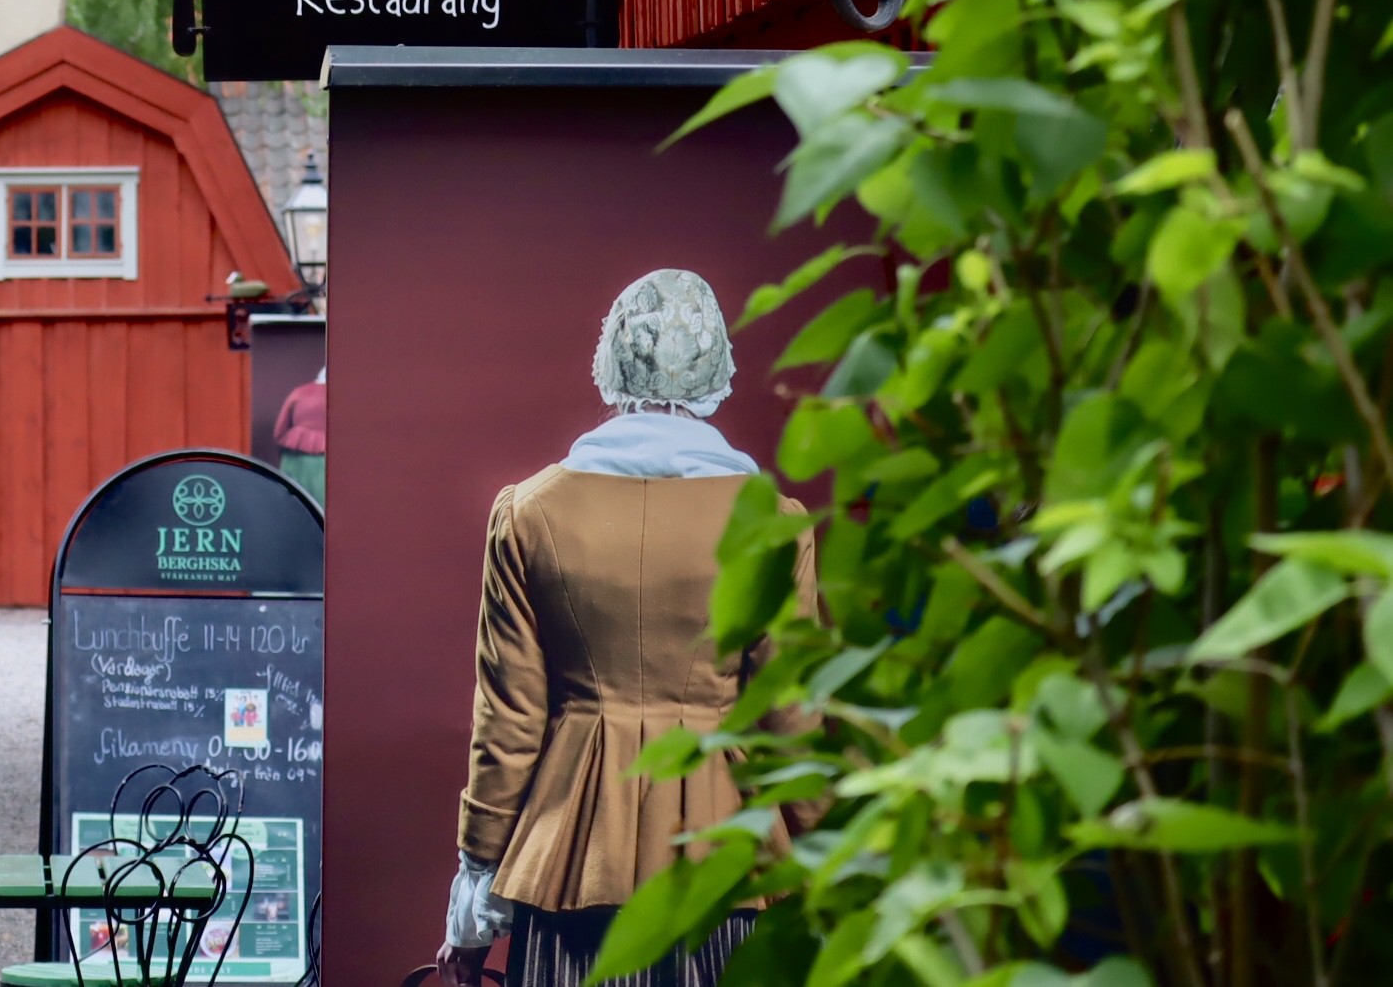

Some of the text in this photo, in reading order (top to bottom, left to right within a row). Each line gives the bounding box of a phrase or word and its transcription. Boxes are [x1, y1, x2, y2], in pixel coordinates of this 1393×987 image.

[156, 527, 242, 556] JERN
[157, 556, 242, 571] BERGHSKA
[204, 624, 240, 651] 11-14
[250, 625, 285, 653] 120
